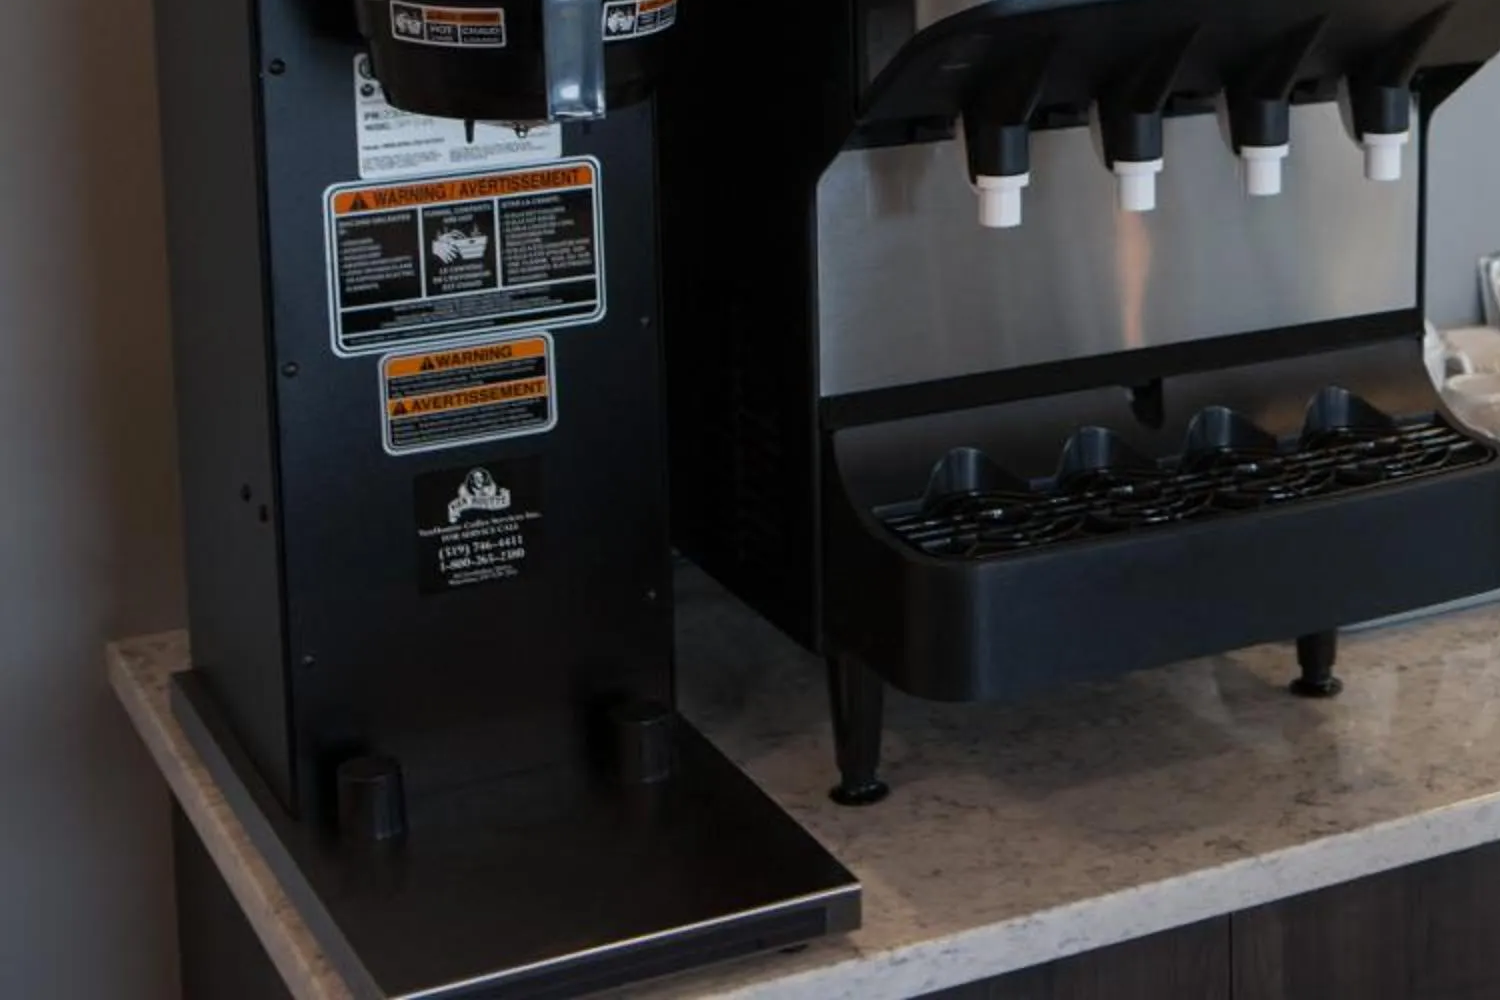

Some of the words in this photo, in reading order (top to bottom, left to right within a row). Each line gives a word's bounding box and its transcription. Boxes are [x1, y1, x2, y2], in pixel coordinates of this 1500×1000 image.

[373, 183, 448, 208] WARNING
[458, 169, 580, 197] AVERTISSEMENT
[435, 345, 513, 369] WARNING
[412, 380, 545, 413] AVERTISSEMENT
